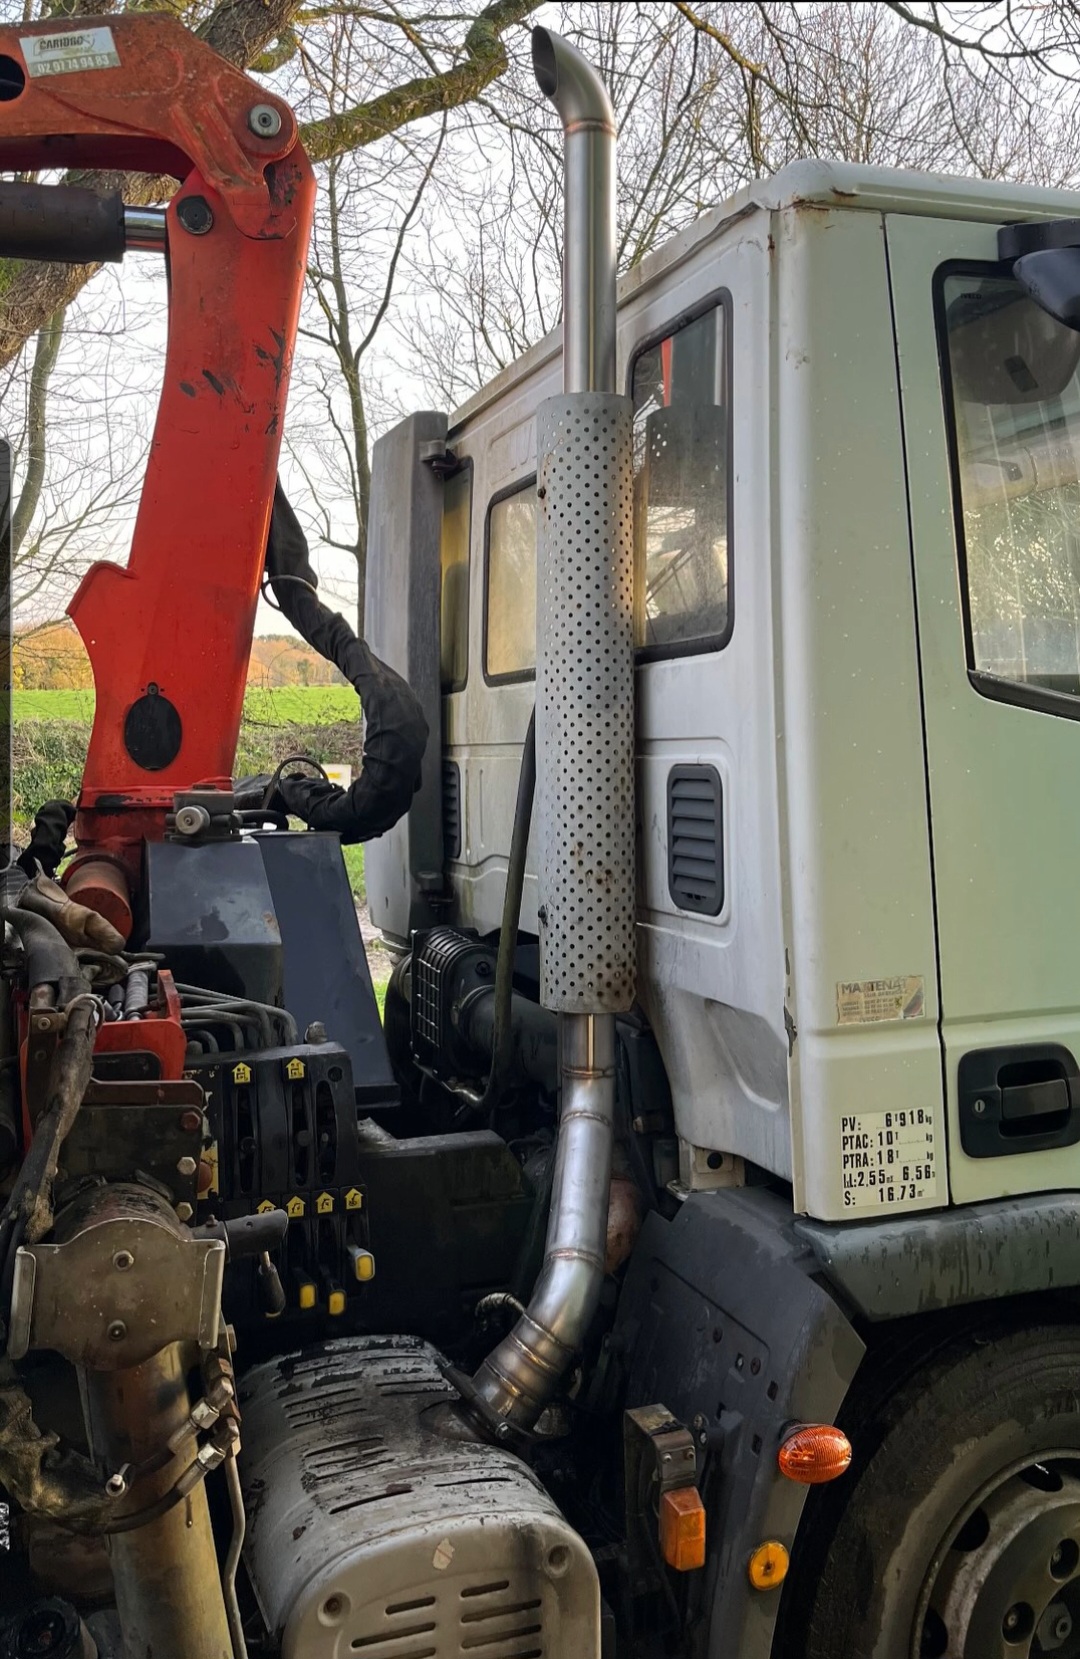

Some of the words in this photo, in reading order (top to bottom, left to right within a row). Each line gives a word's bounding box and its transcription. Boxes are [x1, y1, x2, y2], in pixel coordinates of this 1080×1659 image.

[37, 63, 52, 73] 02
[66, 59, 79, 70] 74
[80, 56, 94, 68] 94
[95, 55, 109, 66] 83
[841, 1116, 861, 1132] PV:
[842, 1133, 873, 1151] PTAC:
[843, 1152, 874, 1169] PTRA:
[844, 1190, 856, 1206] S:
